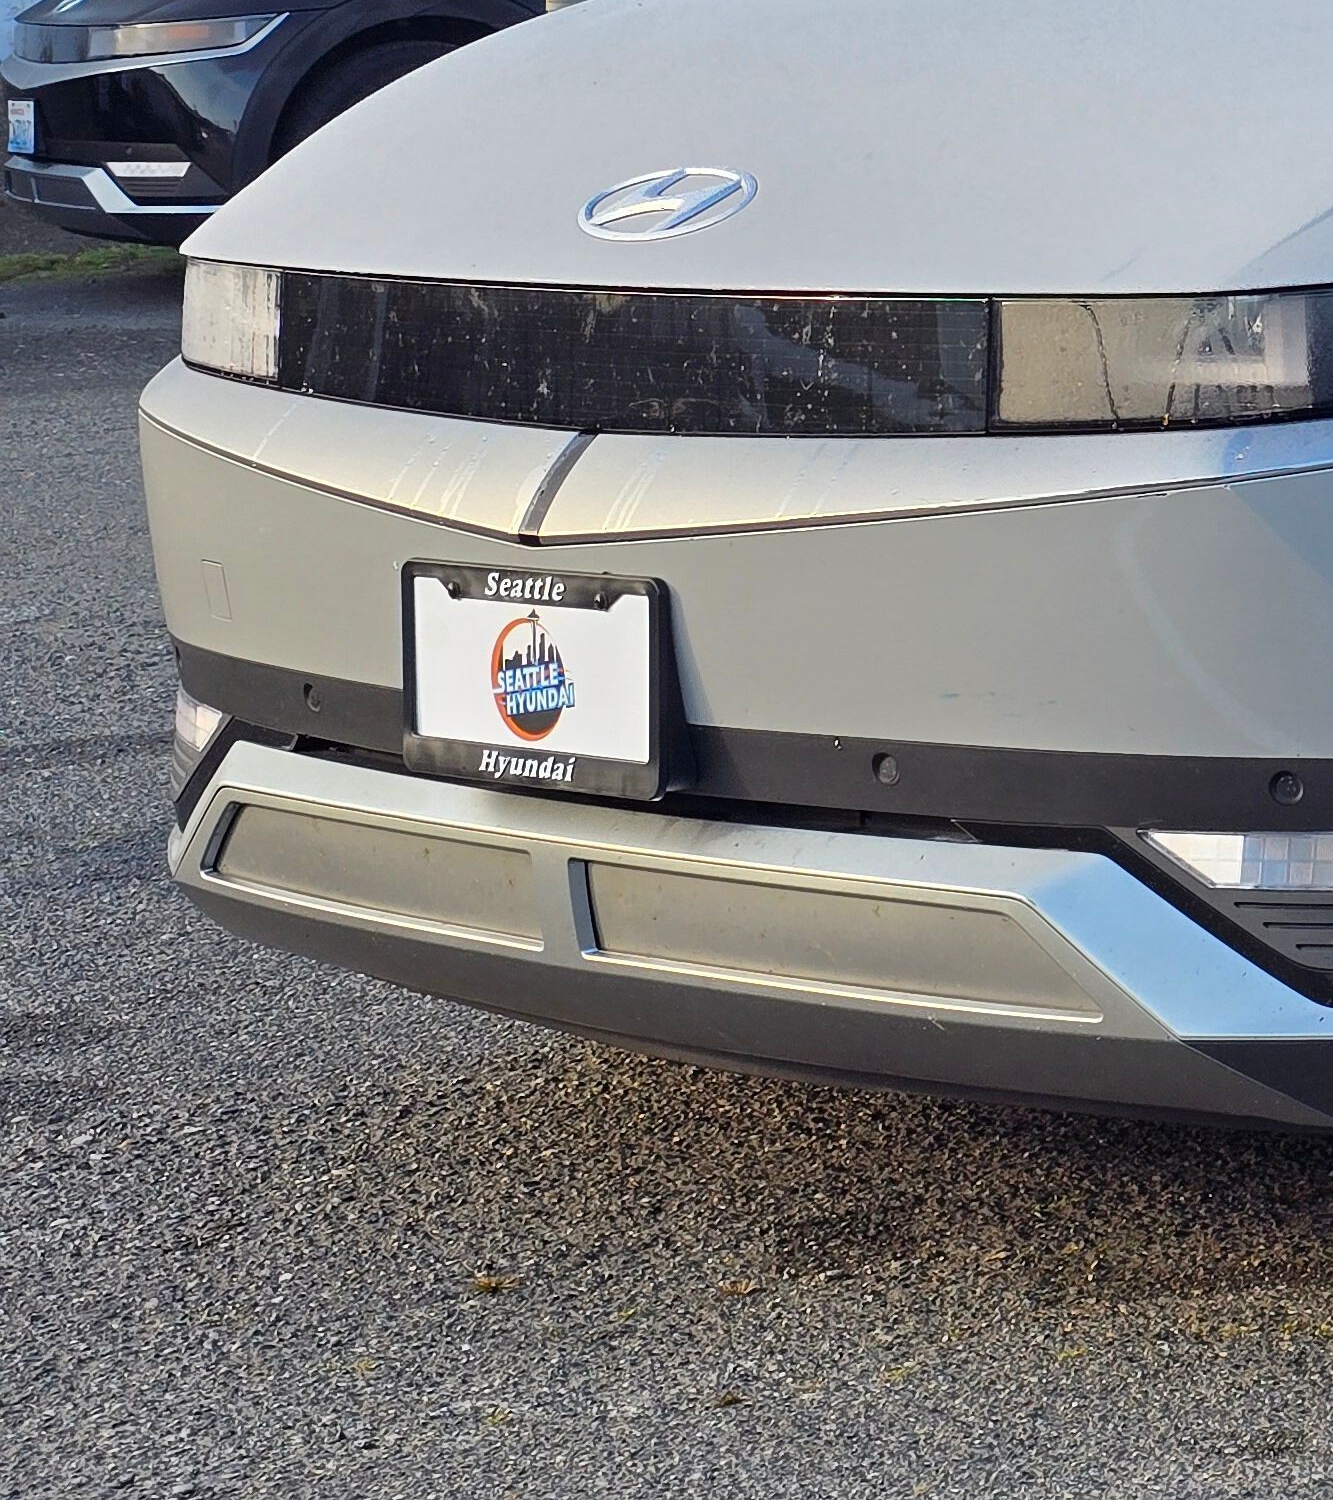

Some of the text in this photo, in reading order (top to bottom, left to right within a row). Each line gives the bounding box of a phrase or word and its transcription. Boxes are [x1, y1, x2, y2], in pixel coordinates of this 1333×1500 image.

[484, 572, 566, 601] Seattle
[497, 662, 560, 693] SEATTLE
[506, 682, 575, 716] HYUNDAI
[479, 749, 576, 783] Hyundai
